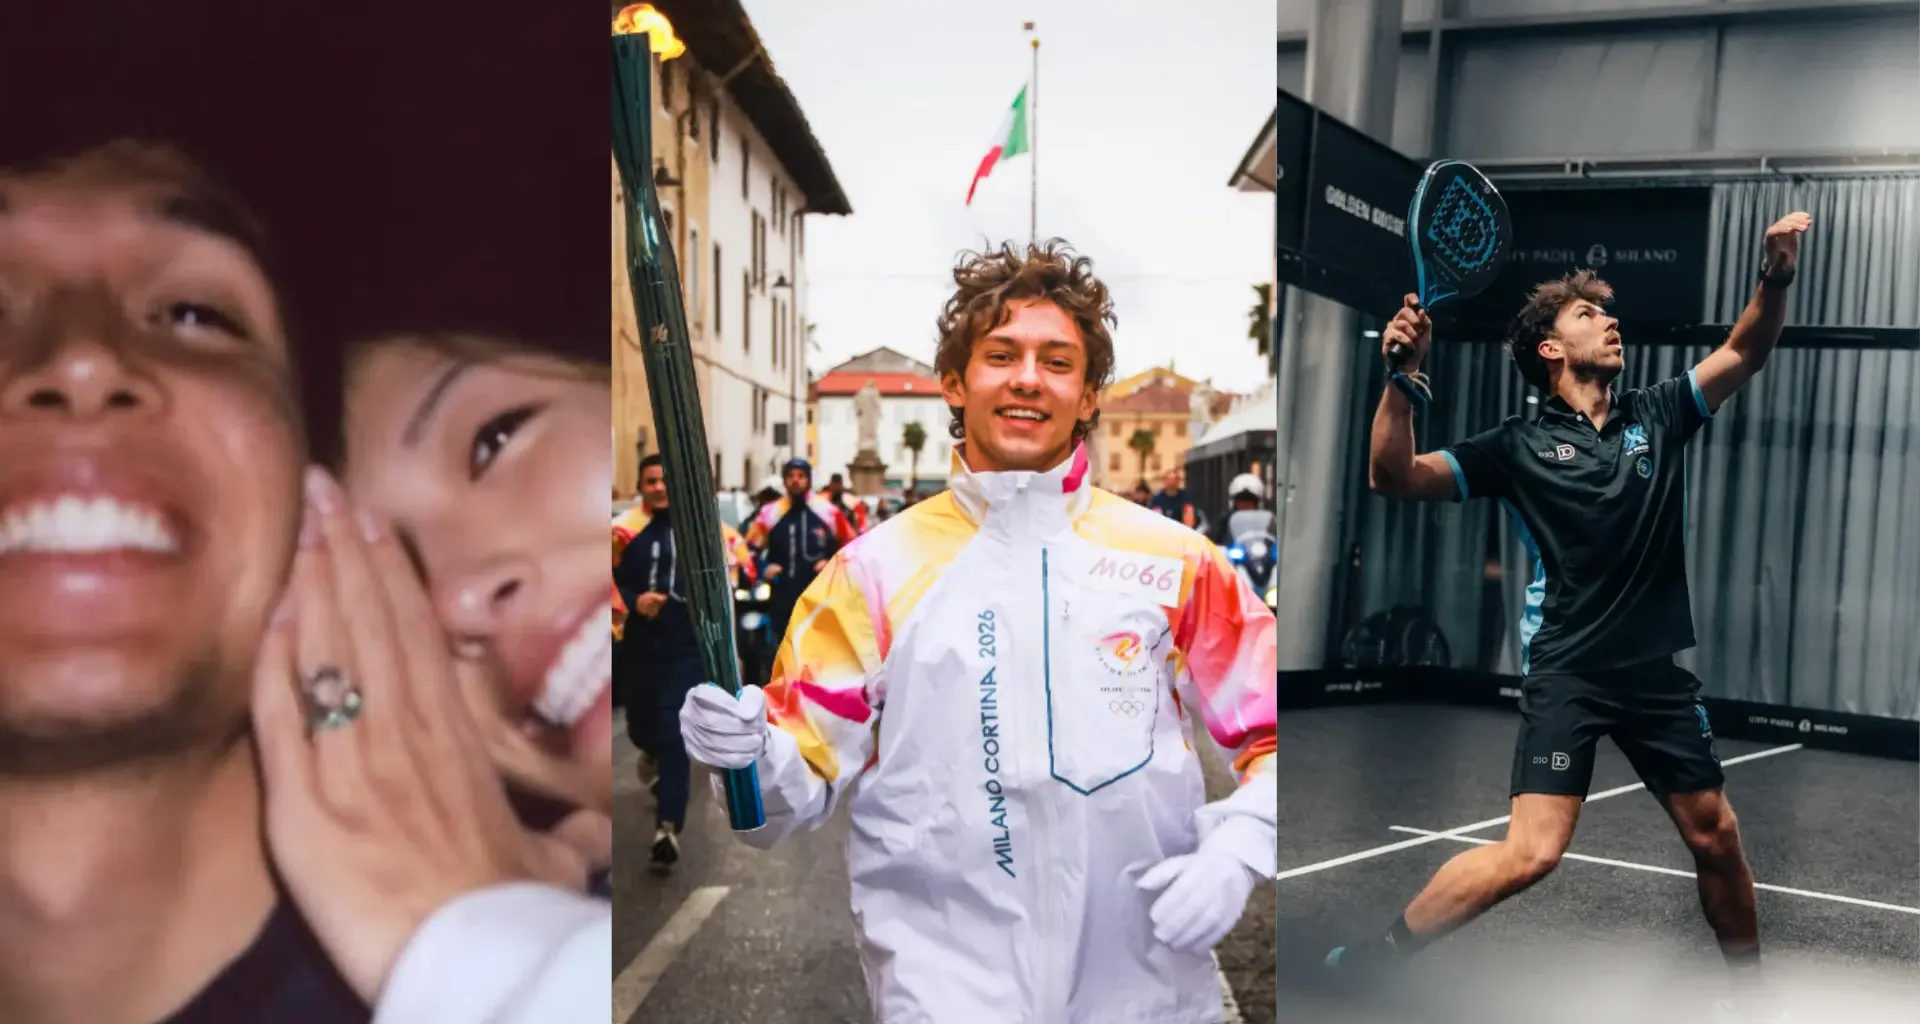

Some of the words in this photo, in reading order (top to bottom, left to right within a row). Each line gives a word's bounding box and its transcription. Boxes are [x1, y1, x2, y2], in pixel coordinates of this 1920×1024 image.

[1613, 247, 1678, 263] MILANO
[977, 609, 998, 659] 2026
[979, 665, 1001, 774] CORTINA
[983, 779, 1016, 878] MILANO
